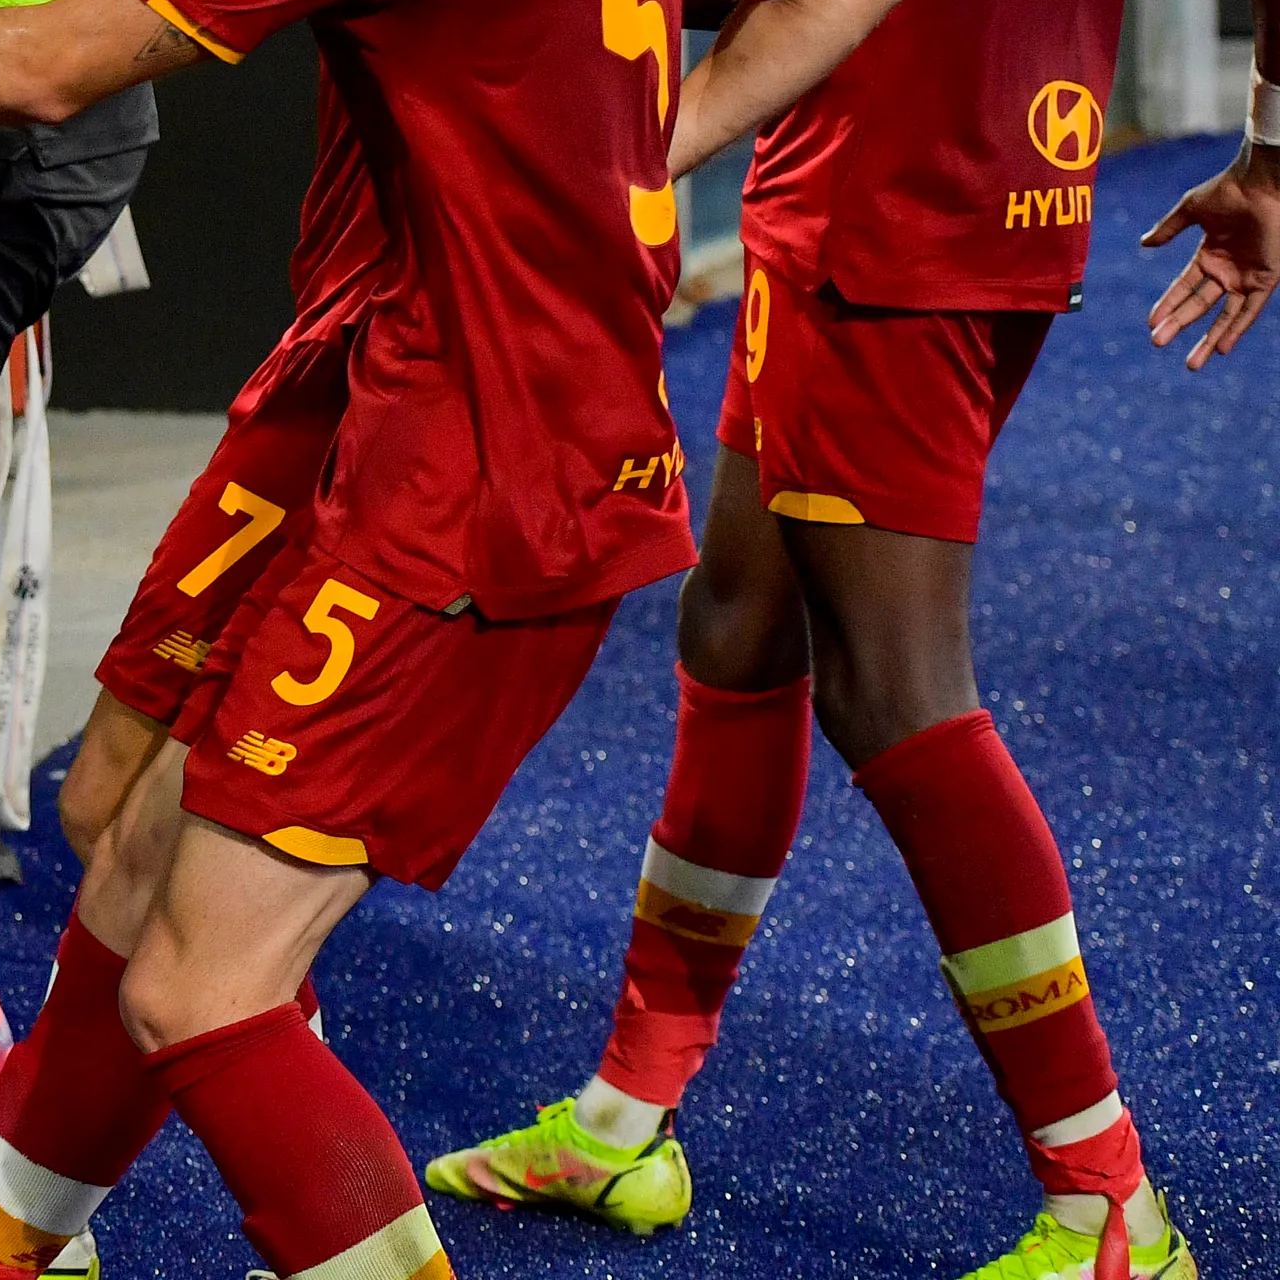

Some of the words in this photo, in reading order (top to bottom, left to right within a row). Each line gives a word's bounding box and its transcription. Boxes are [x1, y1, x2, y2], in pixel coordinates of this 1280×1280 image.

[745, 268, 771, 383] 9
[176, 481, 286, 598] 7
[270, 577, 381, 707] 5
